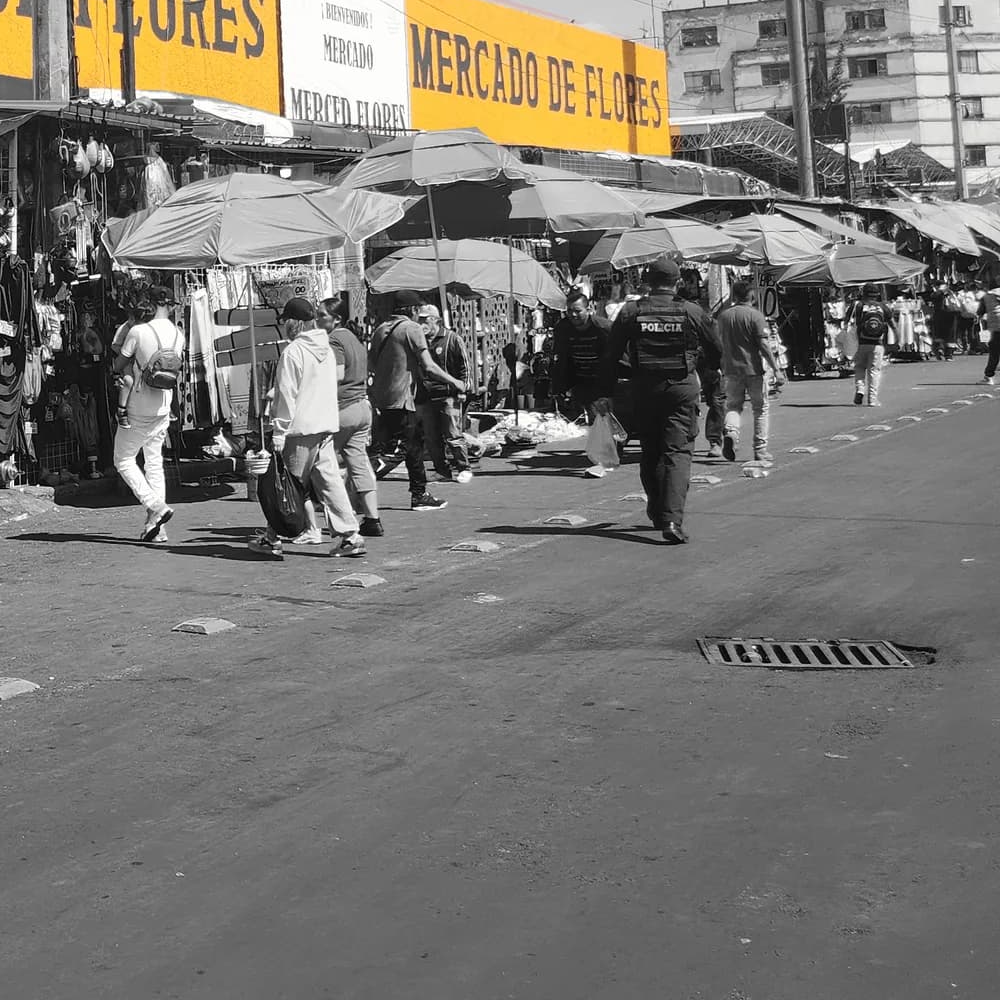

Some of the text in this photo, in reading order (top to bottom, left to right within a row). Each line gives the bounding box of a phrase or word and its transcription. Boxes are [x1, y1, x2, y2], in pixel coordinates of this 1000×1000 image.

[323, 34, 374, 70] MERCADO
[409, 23, 661, 129] MERCADO DE FLORES
